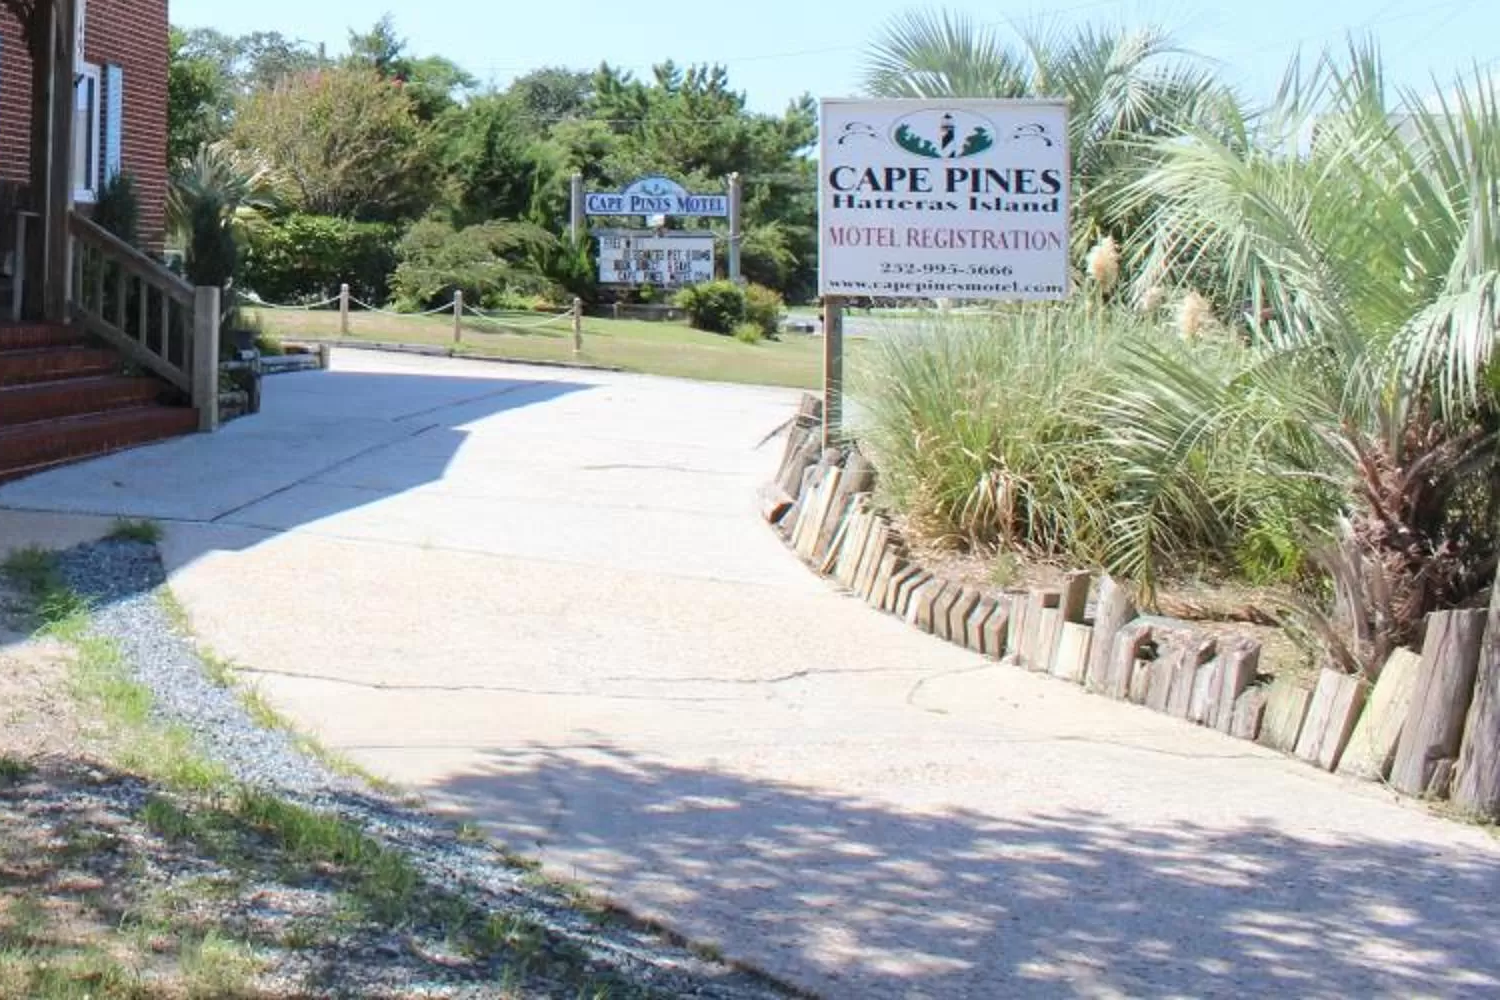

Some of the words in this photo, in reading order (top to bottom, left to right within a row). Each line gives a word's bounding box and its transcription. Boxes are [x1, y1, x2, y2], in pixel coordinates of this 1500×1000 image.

[829, 165, 933, 193] CAPE
[945, 167, 1061, 195] PINES
[588, 195, 623, 212] CAPE
[631, 196, 671, 213] PINES
[677, 196, 725, 214] MOTEL
[832, 194, 958, 212] Hatteras
[969, 197, 1059, 213] Island
[829, 227, 900, 249] MOTEL
[906, 227, 1062, 251] REGISTRATION
[829, 278, 1064, 294] www.capepinesmotel.com
